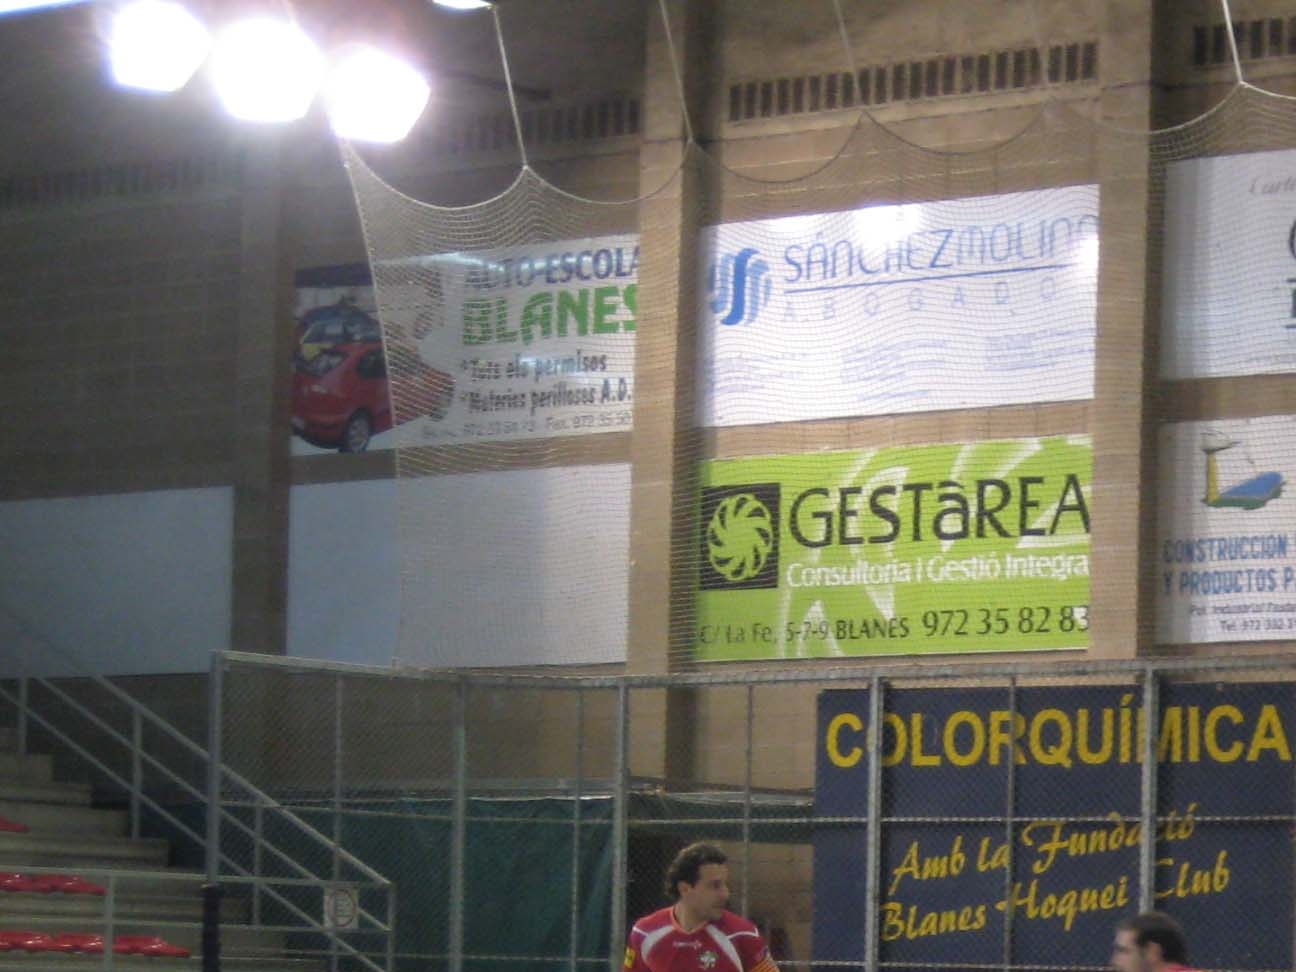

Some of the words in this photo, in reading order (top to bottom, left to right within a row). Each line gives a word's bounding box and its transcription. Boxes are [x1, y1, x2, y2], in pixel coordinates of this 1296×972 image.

[786, 558, 912, 588] Consultoria
[926, 550, 1001, 582] Gestió
[1163, 571, 1173, 596] Y
[1180, 568, 1278, 595] PRODUCTOS
[835, 616, 910, 640] BLANES
[922, 609, 969, 637] 972
[976, 608, 1010, 635] 35
[1018, 606, 1051, 634] 82
[1059, 605, 1090, 633] 83
[825, 693, 1292, 769] COLORQUÍMICA
[889, 836, 967, 895] Amb
[976, 836, 1010, 873] la
[1021, 803, 1197, 874] Fundaió
[878, 901, 987, 942] Blanes
[994, 875, 1129, 931] Hoquei
